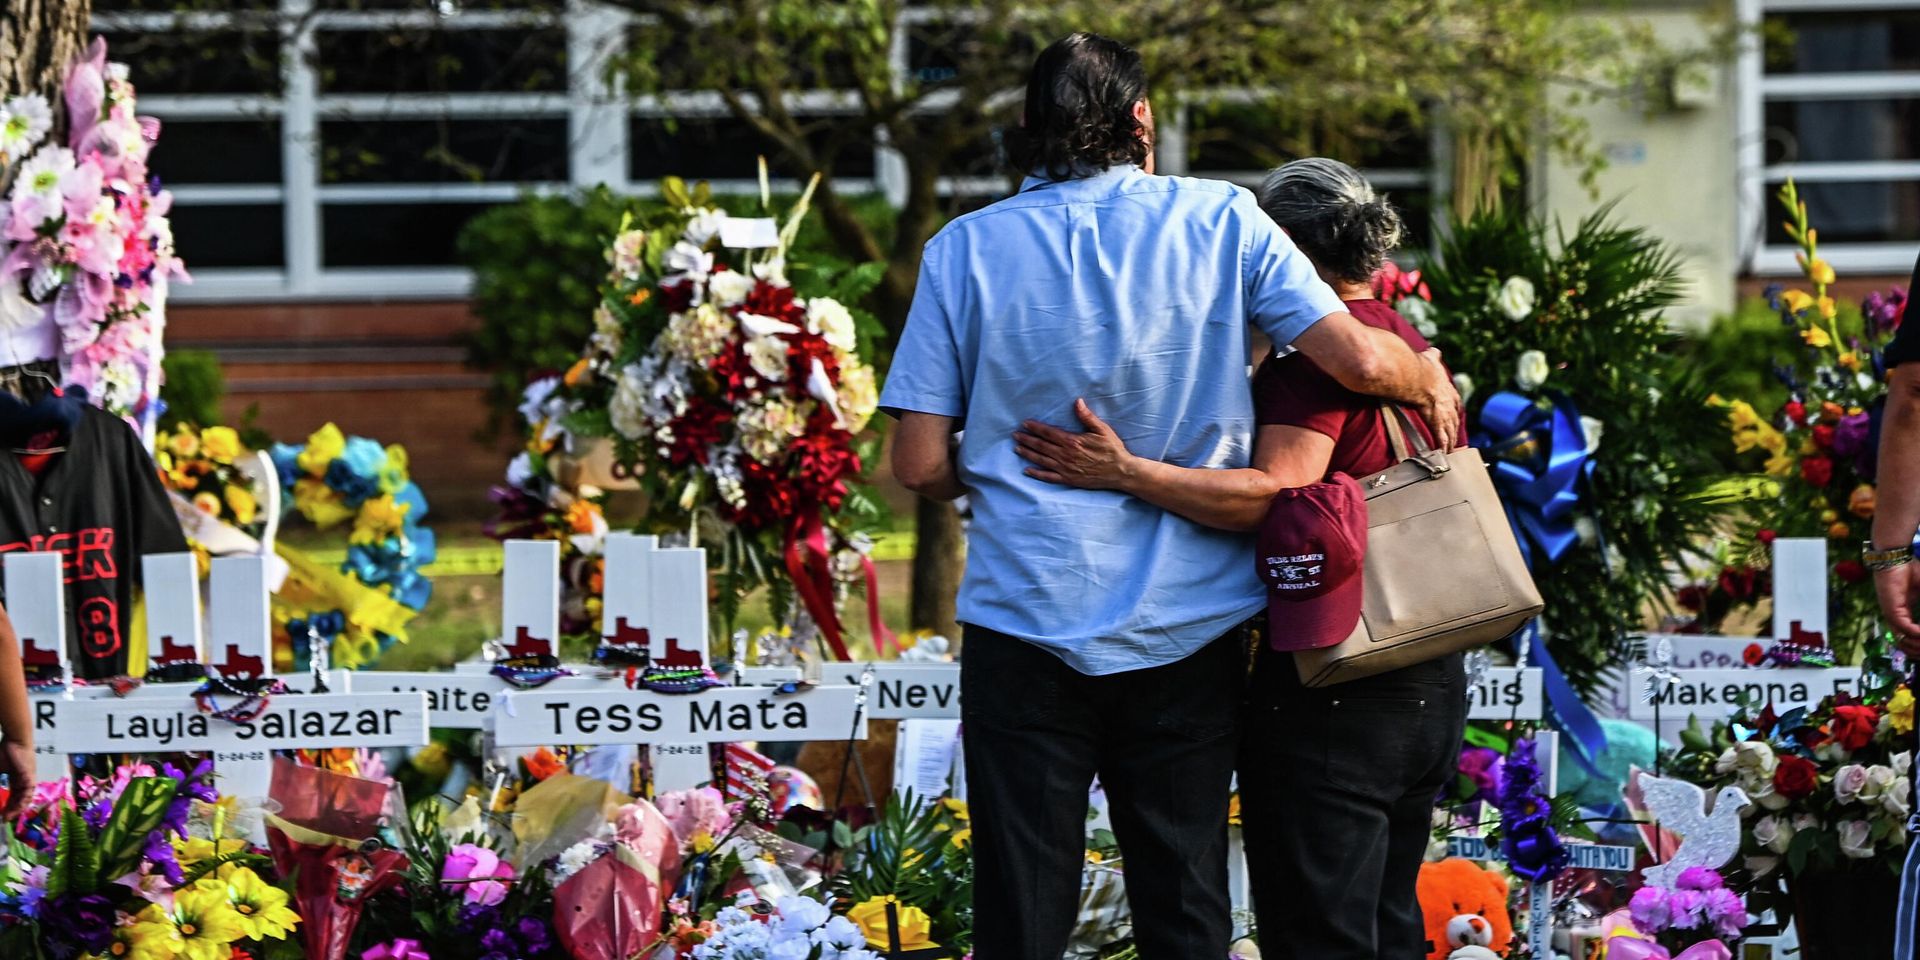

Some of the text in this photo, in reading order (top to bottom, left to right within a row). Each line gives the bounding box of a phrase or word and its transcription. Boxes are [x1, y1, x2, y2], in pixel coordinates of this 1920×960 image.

[79, 596, 122, 658] 8
[392, 686, 491, 712] aite
[878, 680, 962, 710] Nev
[1649, 681, 1809, 706] Makenna
[107, 708, 403, 744] Layla Salazar
[545, 698, 808, 735] Tess Mata
[656, 744, 703, 755] 5-24-22
[1601, 846, 1629, 869] YOU
